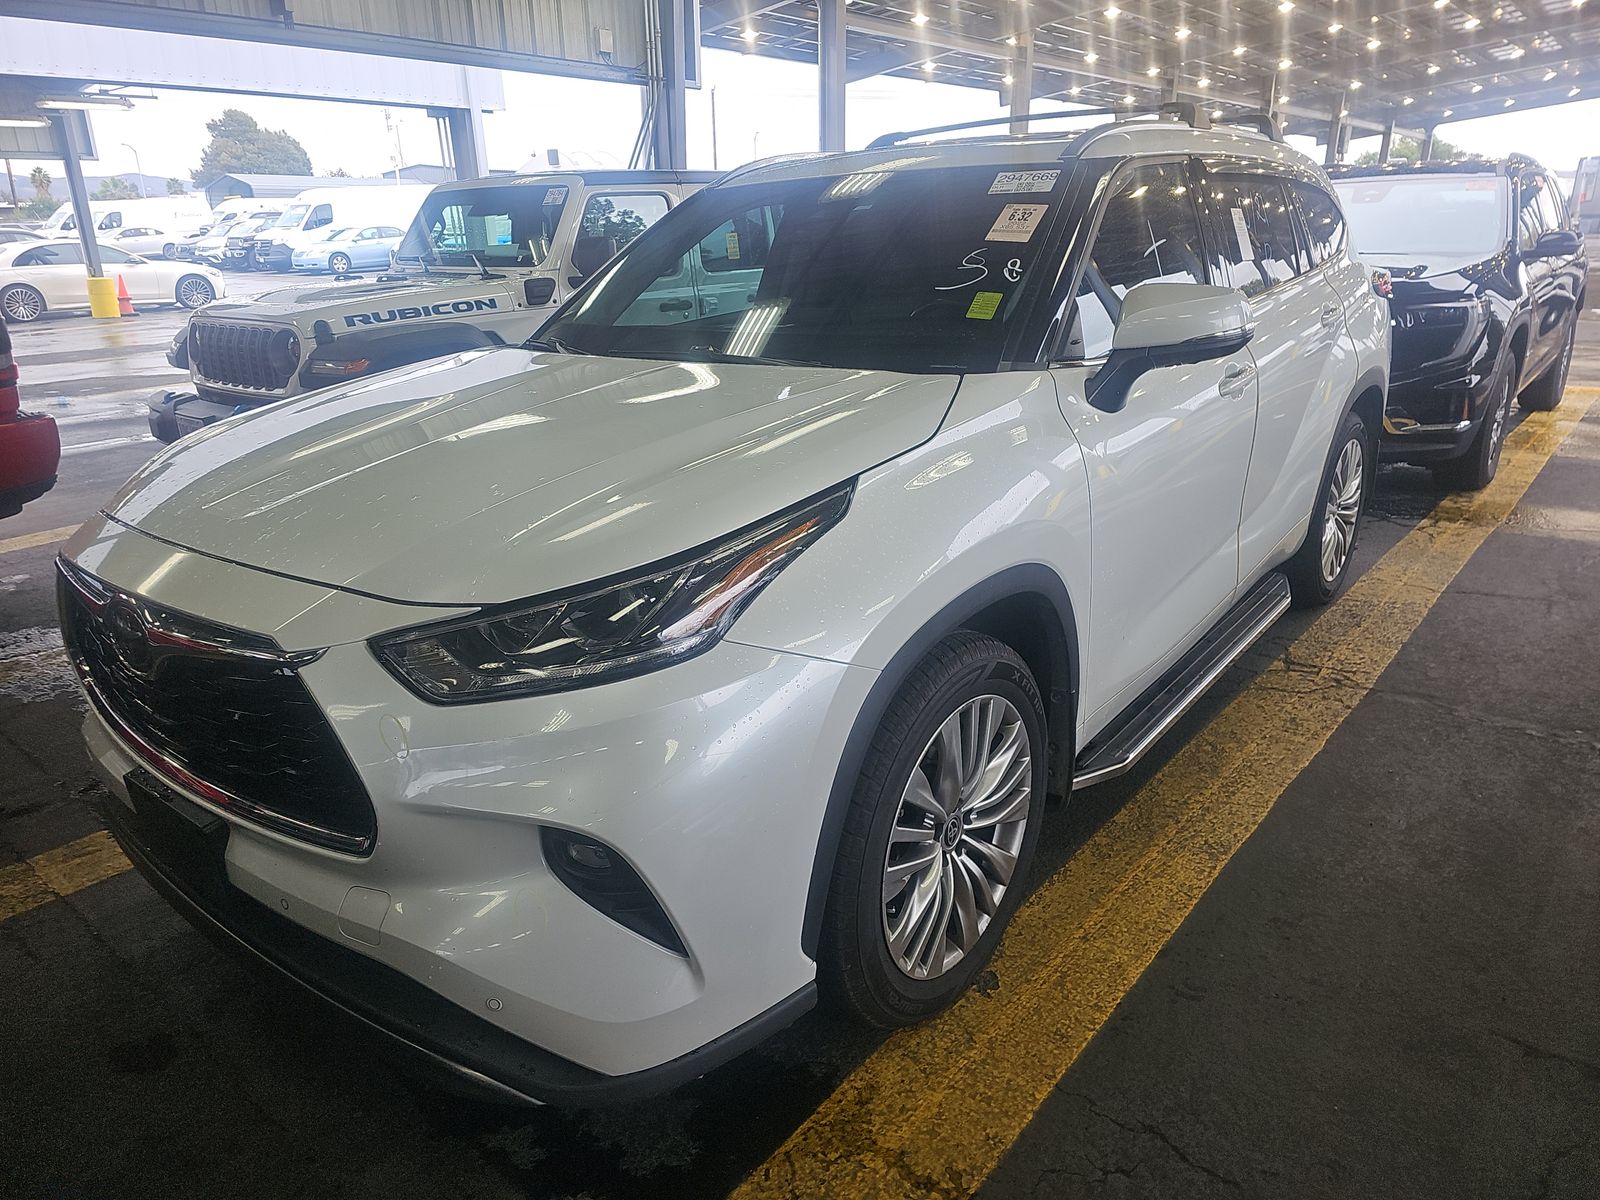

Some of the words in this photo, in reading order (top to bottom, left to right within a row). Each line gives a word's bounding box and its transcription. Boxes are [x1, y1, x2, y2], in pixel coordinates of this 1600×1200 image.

[998, 171, 1059, 183] 2947669
[1008, 211, 1033, 222] 6:32
[343, 298, 498, 328] RUBICON
